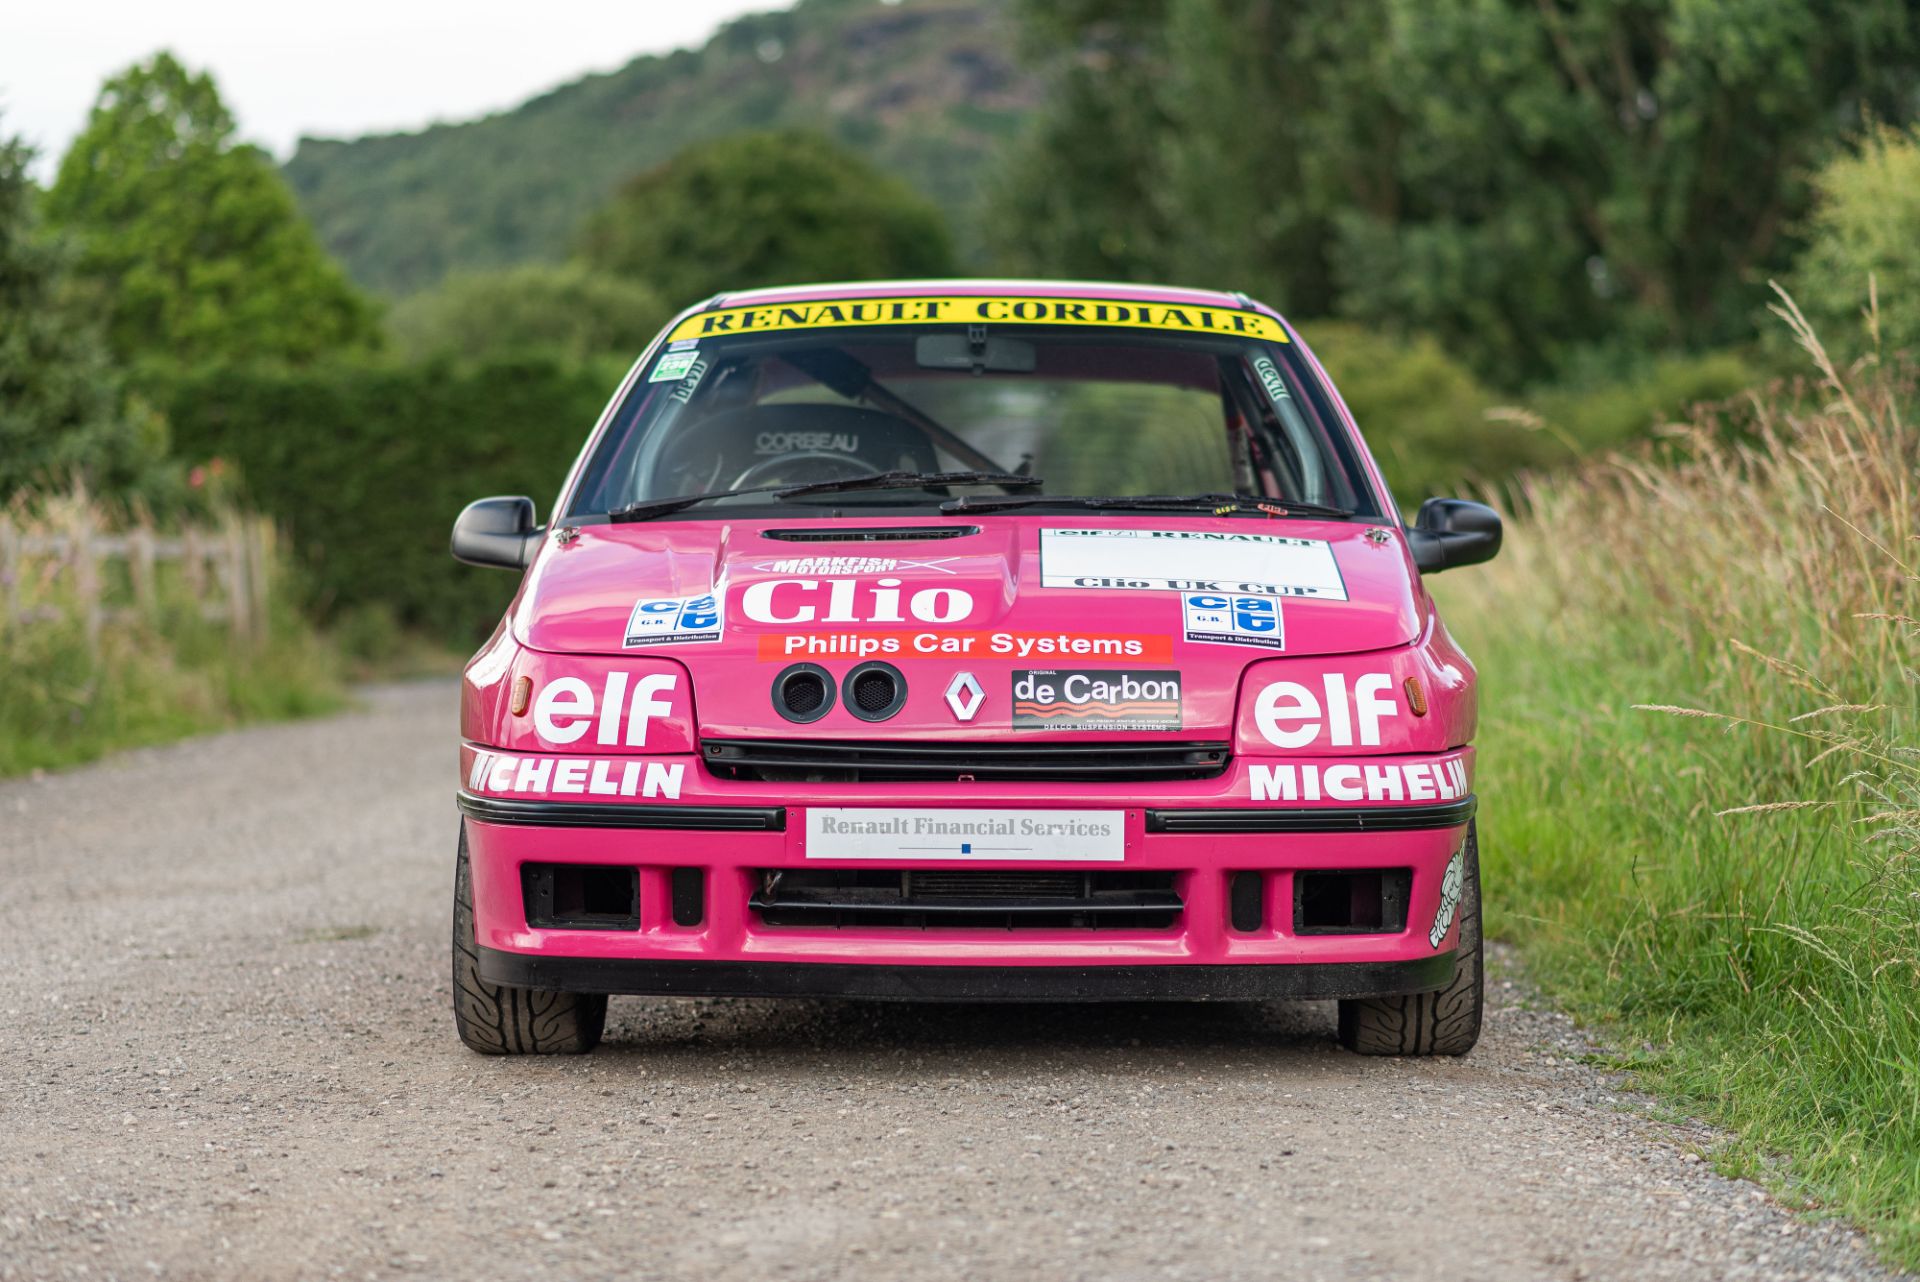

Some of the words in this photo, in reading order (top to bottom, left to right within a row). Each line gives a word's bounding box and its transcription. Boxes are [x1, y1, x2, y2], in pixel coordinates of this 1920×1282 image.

[701, 302, 950, 334] RENAULT
[976, 301, 1264, 335] CORDIALE
[757, 431, 859, 452] CORBEAU
[1151, 531, 1317, 547] RENAULT
[1074, 577, 1150, 589] Clio
[1167, 580, 1221, 591] UK
[1238, 583, 1318, 596] CUP
[742, 578, 974, 624] Clio
[629, 636, 665, 644] Transport
[784, 634, 900, 657] Philips
[913, 633, 976, 653] Car
[990, 633, 1143, 657] Systems
[1189, 633, 1227, 641] Transport
[1235, 635, 1279, 645] Distribution
[1014, 675, 1055, 704] de
[1063, 674, 1179, 704] Carbon
[533, 671, 677, 747] elf
[1254, 672, 1398, 748] elf
[468, 752, 685, 800] MICHELIN
[1248, 758, 1468, 801] MICHELIN
[821, 815, 908, 835] Renault
[913, 816, 1016, 836] Financial
[1020, 818, 1111, 837] Services
